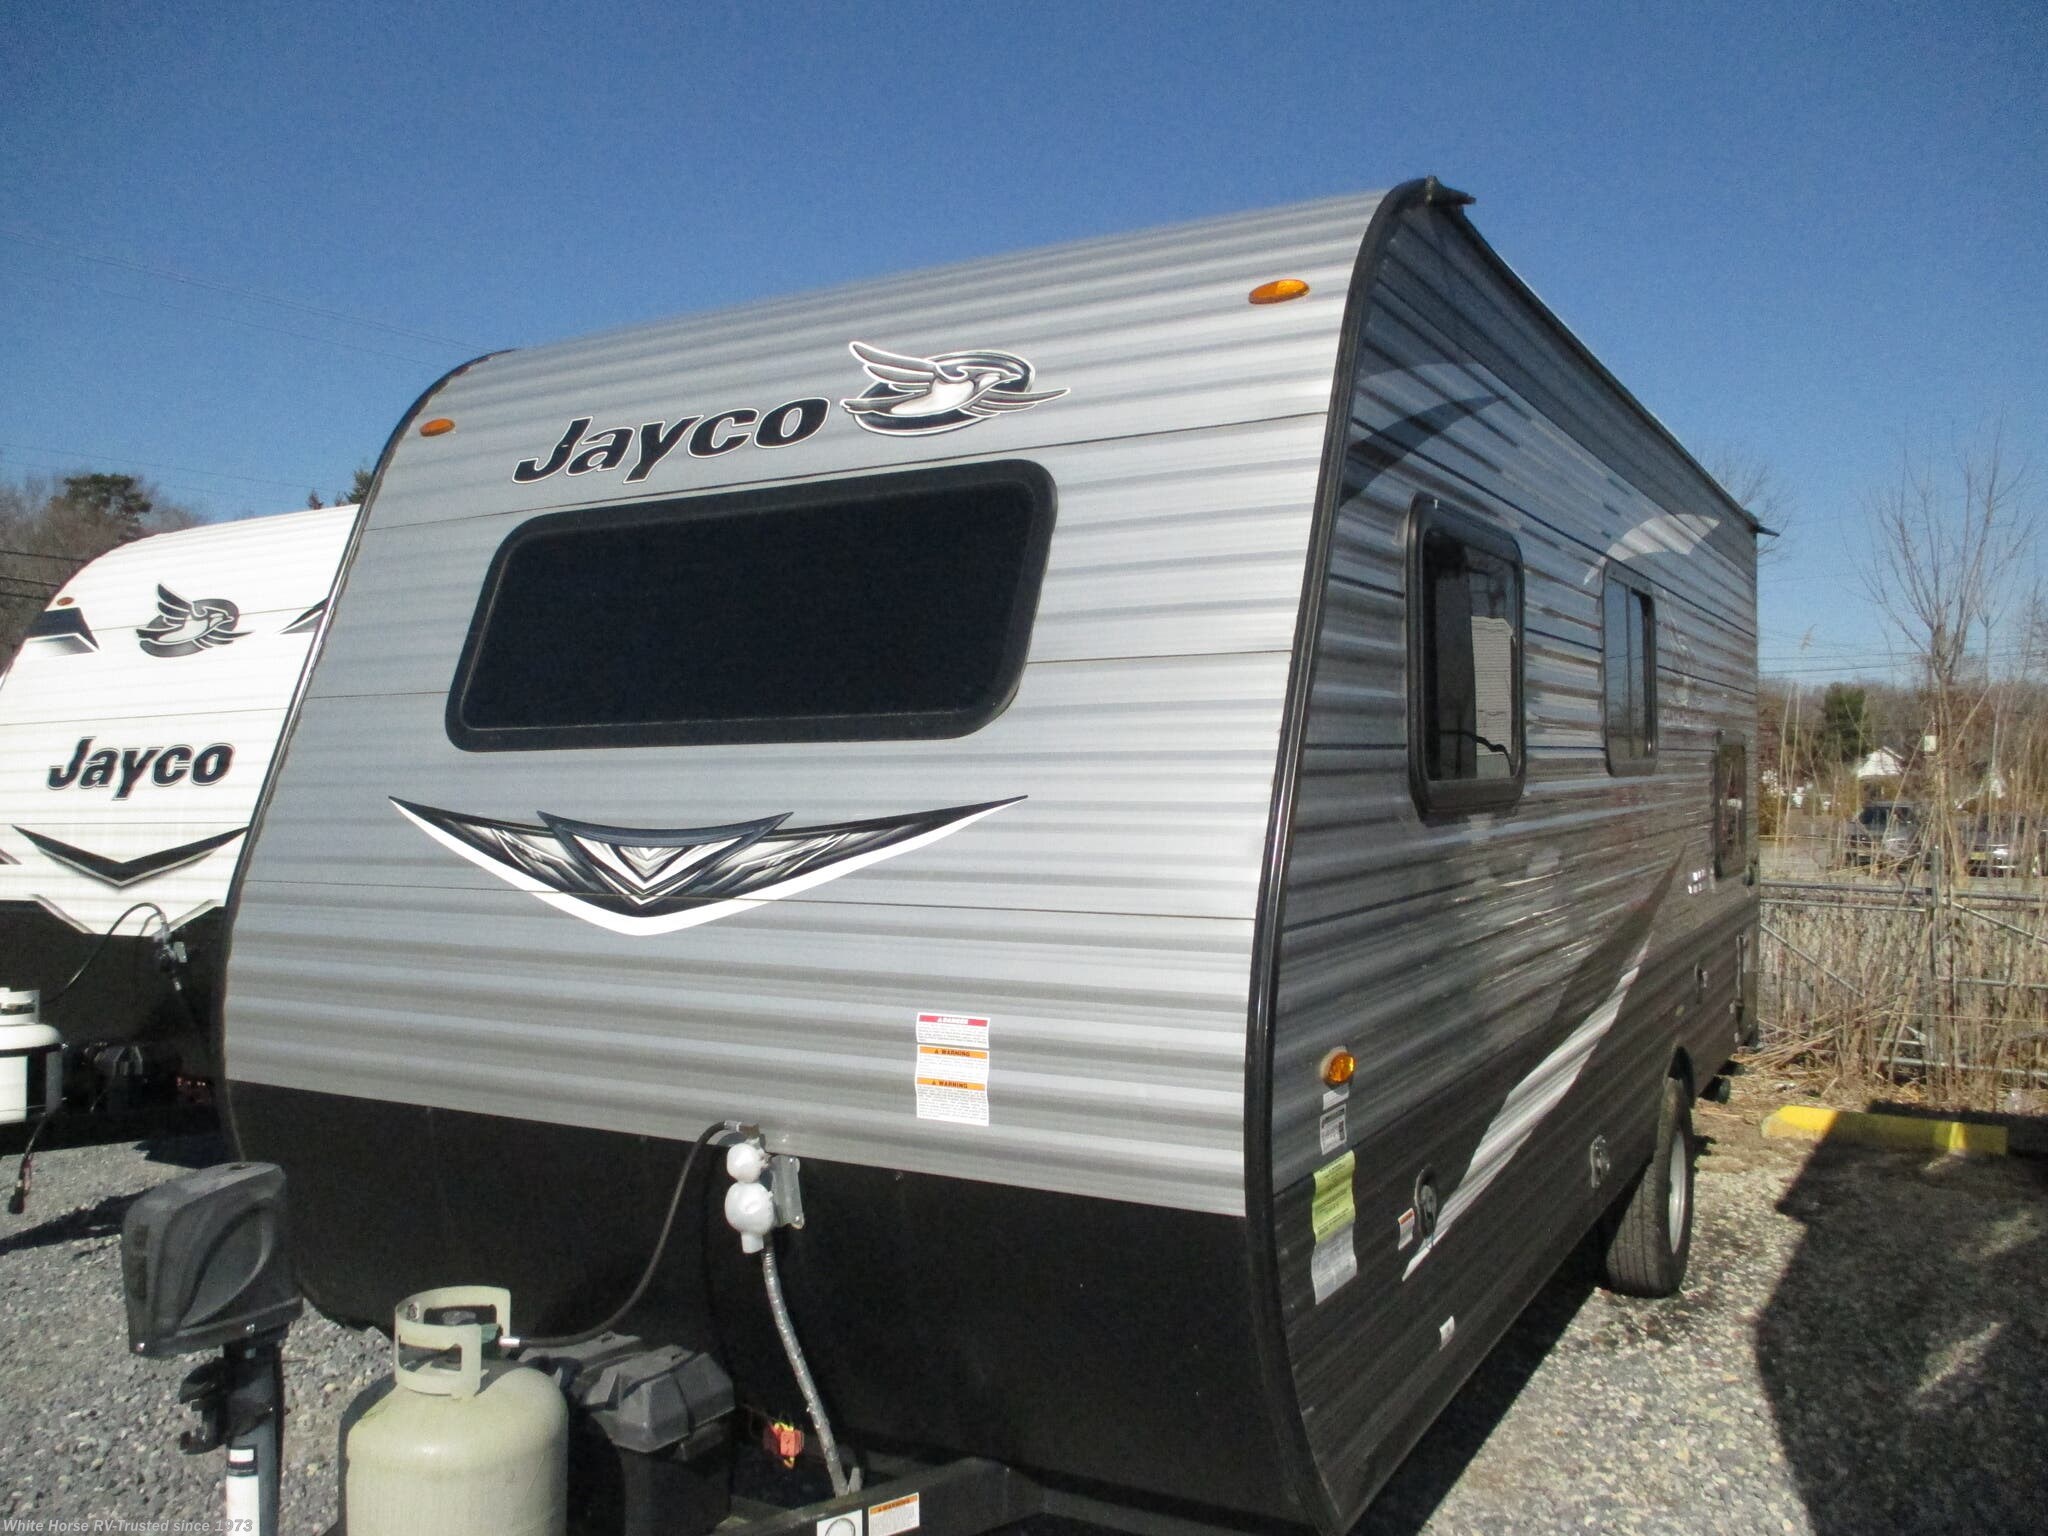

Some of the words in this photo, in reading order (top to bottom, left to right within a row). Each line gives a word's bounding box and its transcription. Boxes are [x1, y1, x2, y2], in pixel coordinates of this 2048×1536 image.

[511, 397, 830, 484] Jayco
[47, 736, 236, 801] Jayco
[941, 1049, 970, 1057] WARNING
[938, 1079, 968, 1089] WARNING
